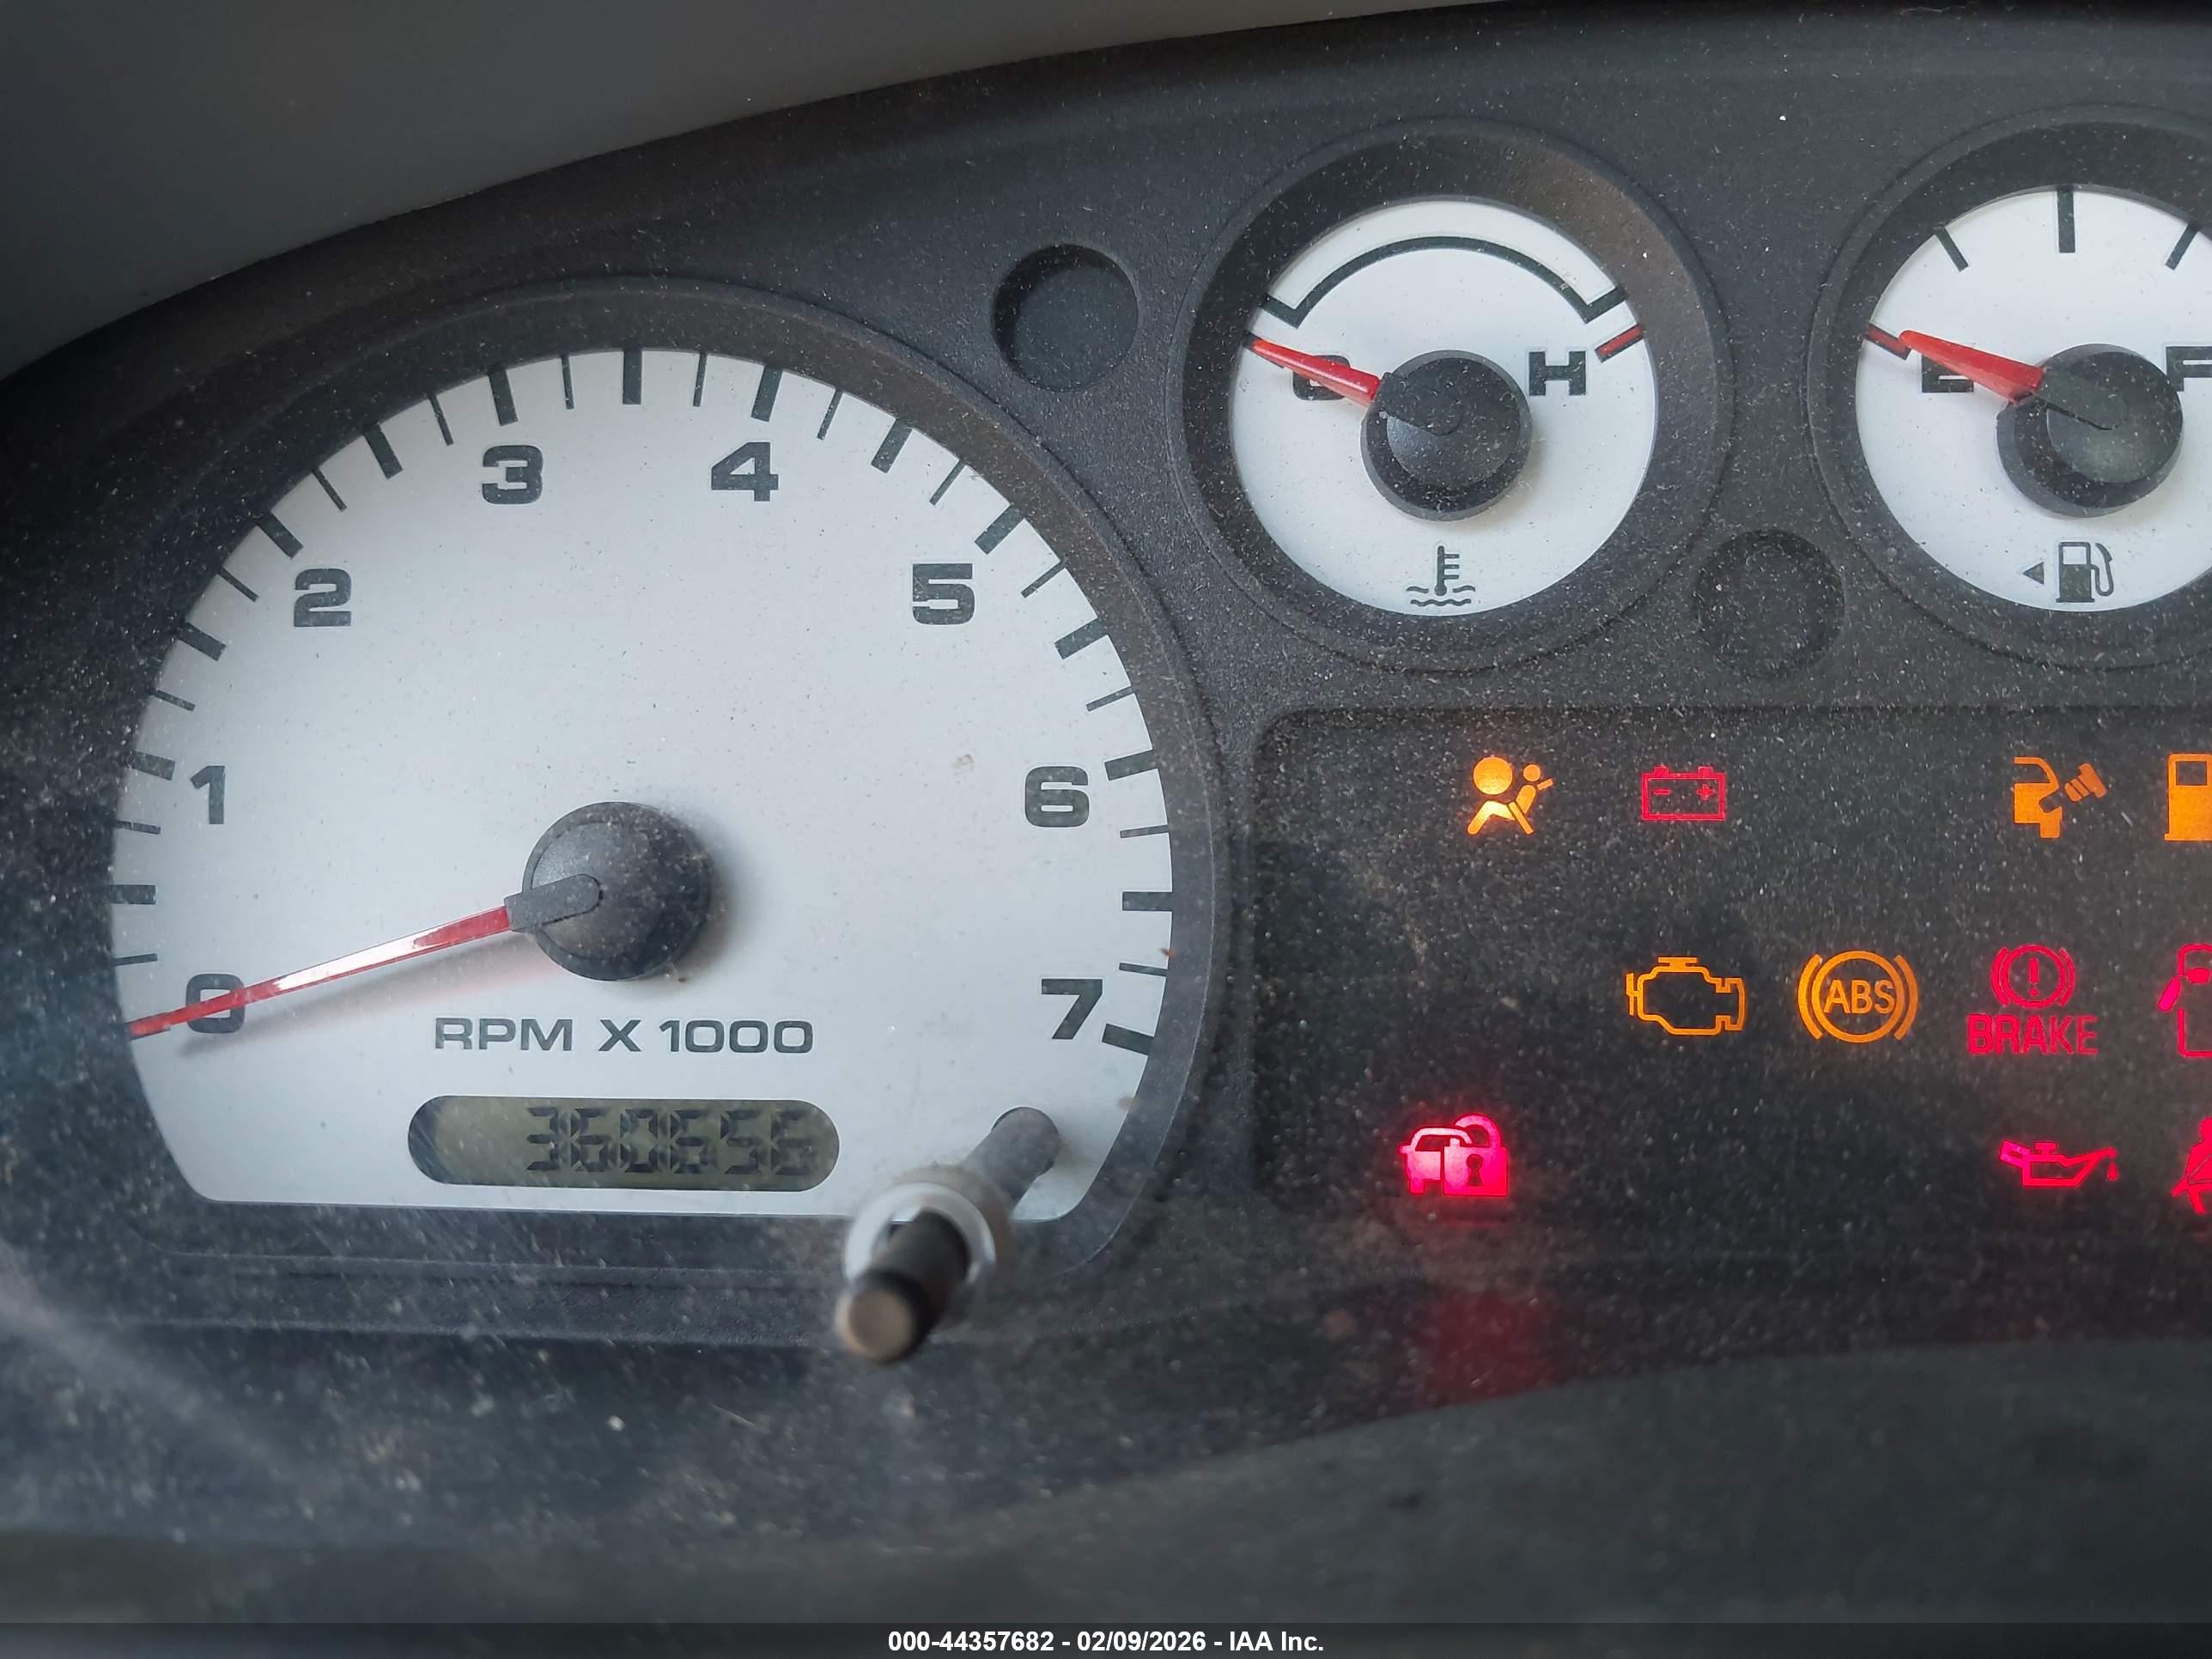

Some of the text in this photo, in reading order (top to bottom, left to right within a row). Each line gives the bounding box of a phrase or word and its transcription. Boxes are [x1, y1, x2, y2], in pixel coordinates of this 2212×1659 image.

[1528, 350, 1586, 396] H
[482, 445, 544, 504] 3
[711, 442, 779, 501] 4
[294, 568, 352, 627] 2
[912, 562, 975, 625] 5
[190, 765, 226, 824] 1
[1024, 765, 1091, 828] 6
[185, 973, 246, 1033] 0
[1041, 978, 1103, 1040] 7
[1824, 979, 1895, 1014] ABS
[434, 1018, 814, 1054] RPM X 1000
[1967, 1013, 2099, 1055] BRAKE
[526, 1106, 821, 1176] 360656
